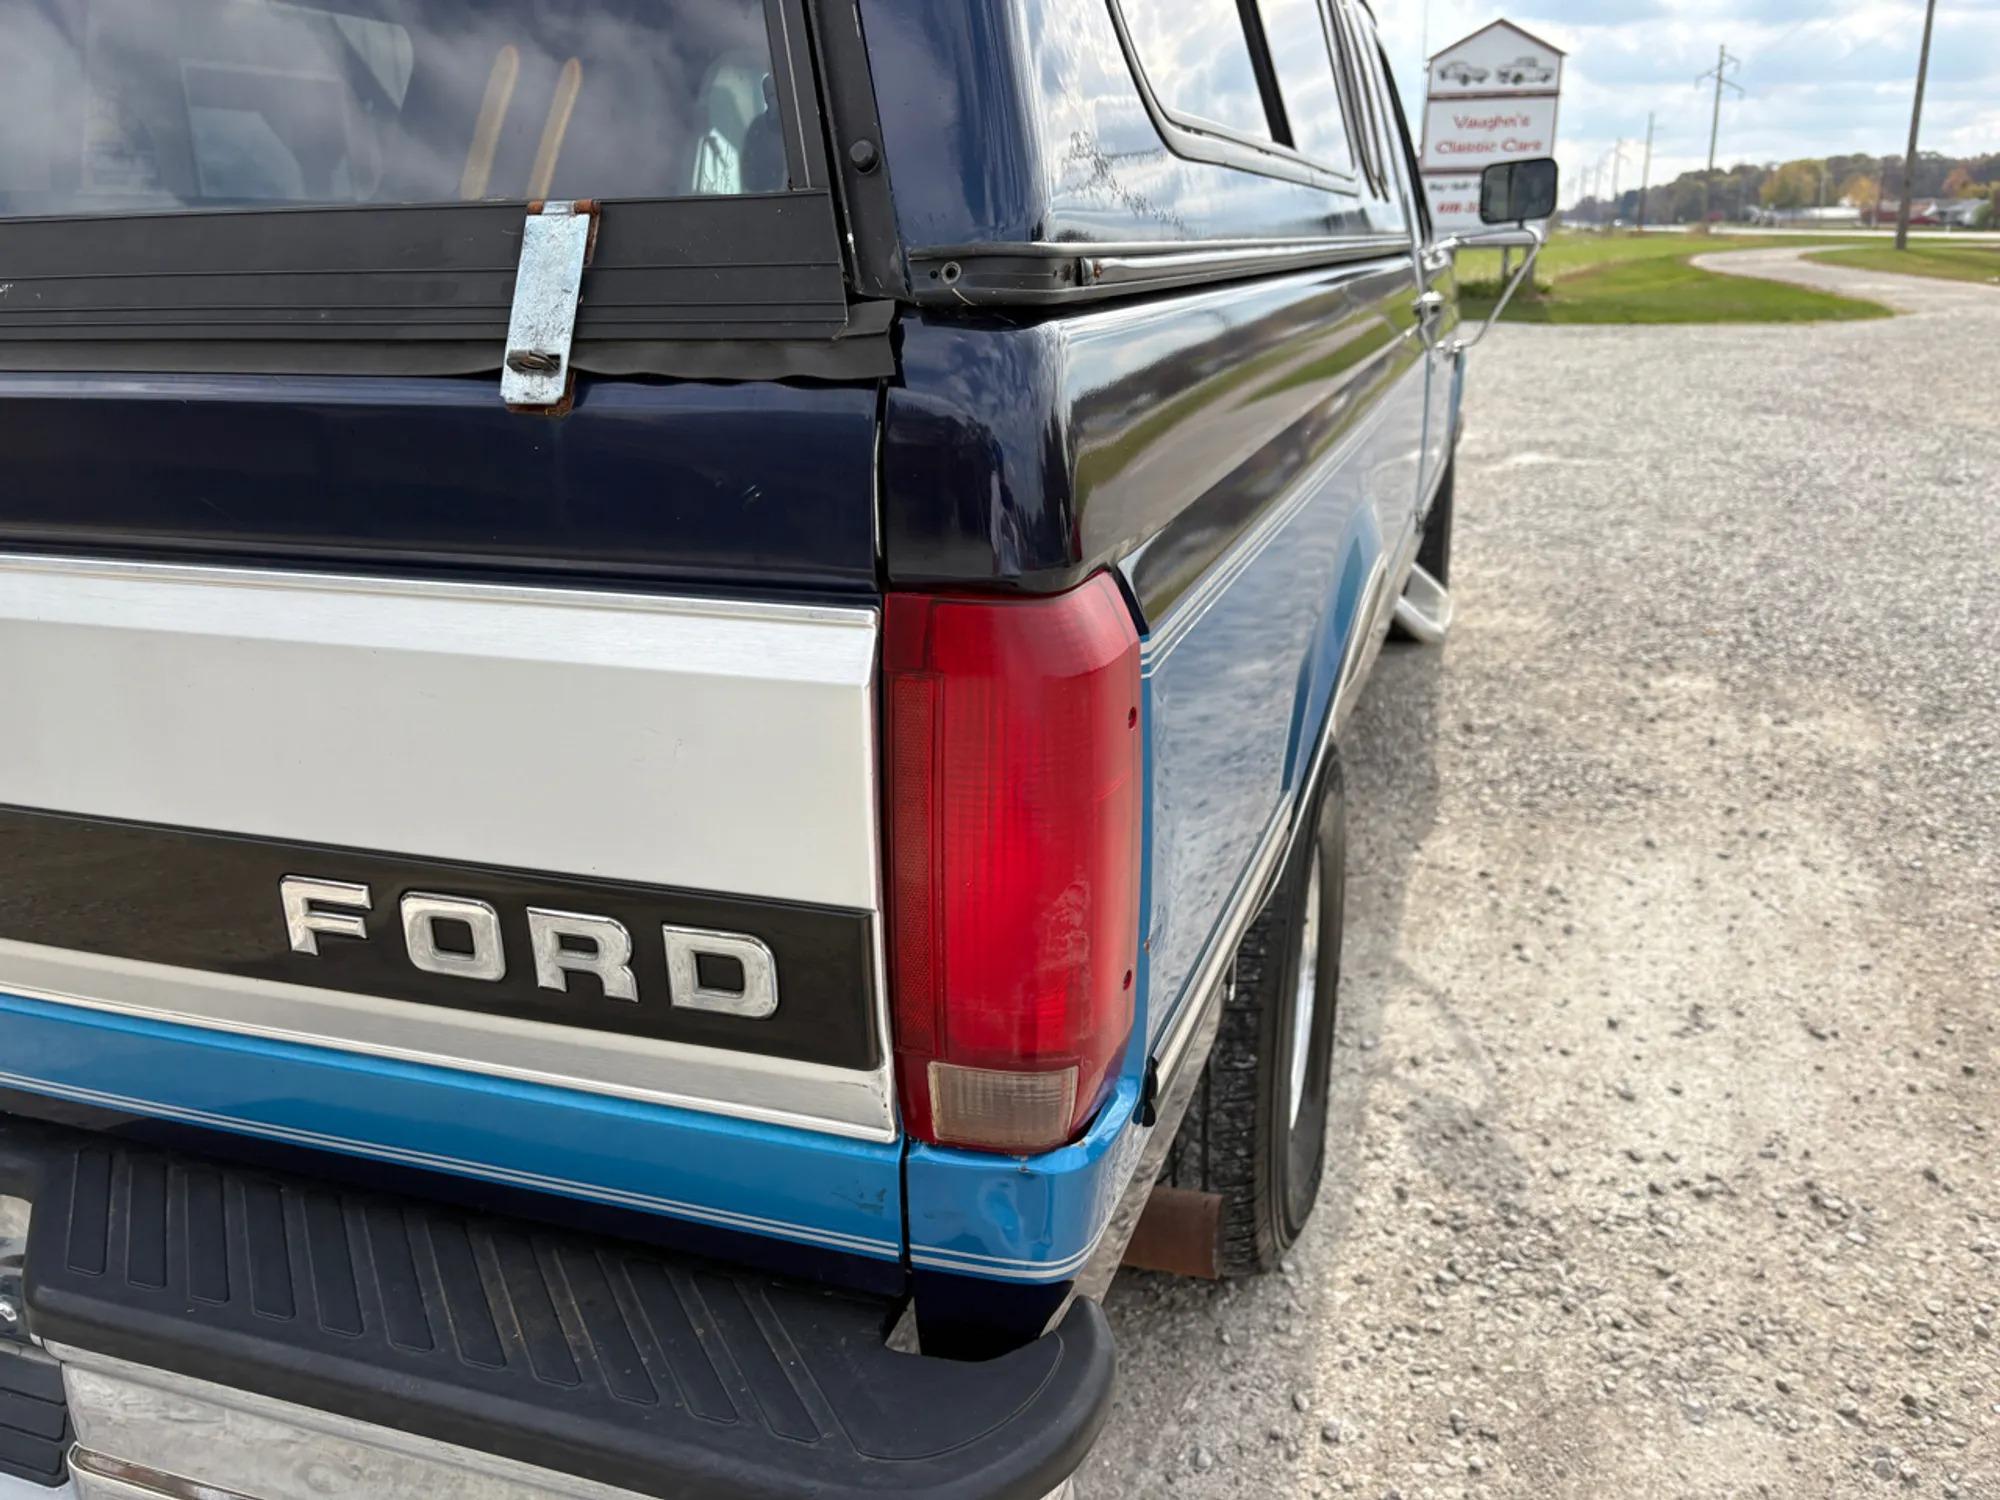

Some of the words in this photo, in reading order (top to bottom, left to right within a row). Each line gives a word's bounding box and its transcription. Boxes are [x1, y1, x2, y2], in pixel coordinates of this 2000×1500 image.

[1453, 114, 1531, 132] Vaughn's
[1436, 140, 1496, 154] Classic
[1502, 137, 1542, 152] Cars
[280, 874, 779, 1020] FORD
